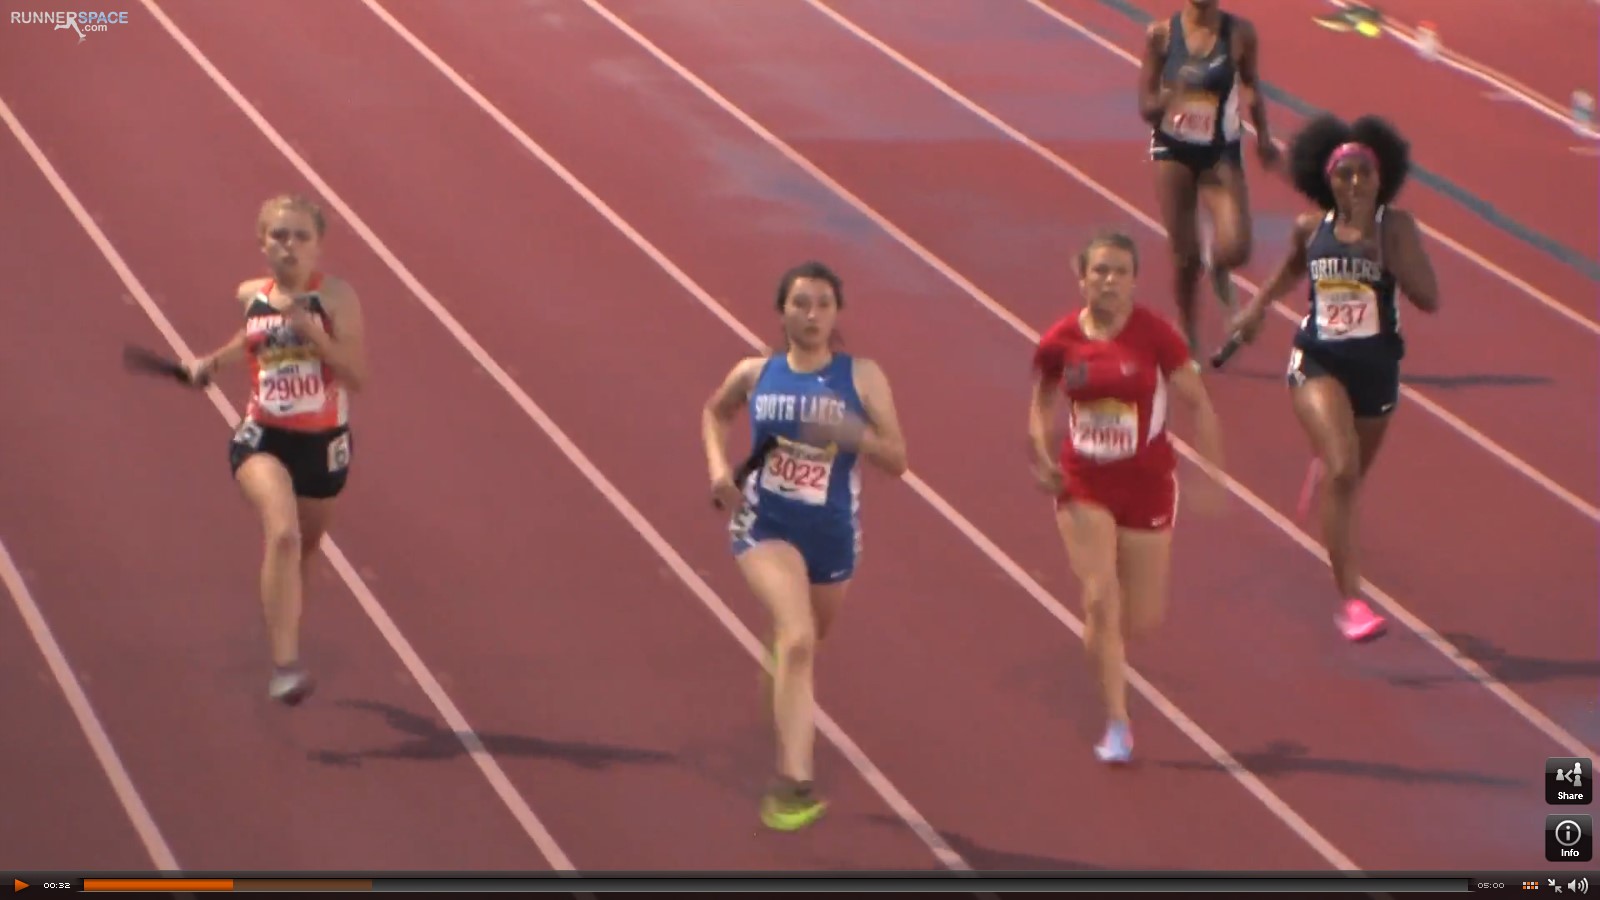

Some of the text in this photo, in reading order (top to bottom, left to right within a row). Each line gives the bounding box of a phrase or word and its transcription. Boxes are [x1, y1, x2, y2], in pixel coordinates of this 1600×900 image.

[1311, 258, 1381, 281] DRILLERS
[1326, 303, 1367, 325] 237
[263, 375, 320, 401] 2900
[755, 394, 846, 424] SOUTH LAKES
[769, 453, 827, 488] 3022
